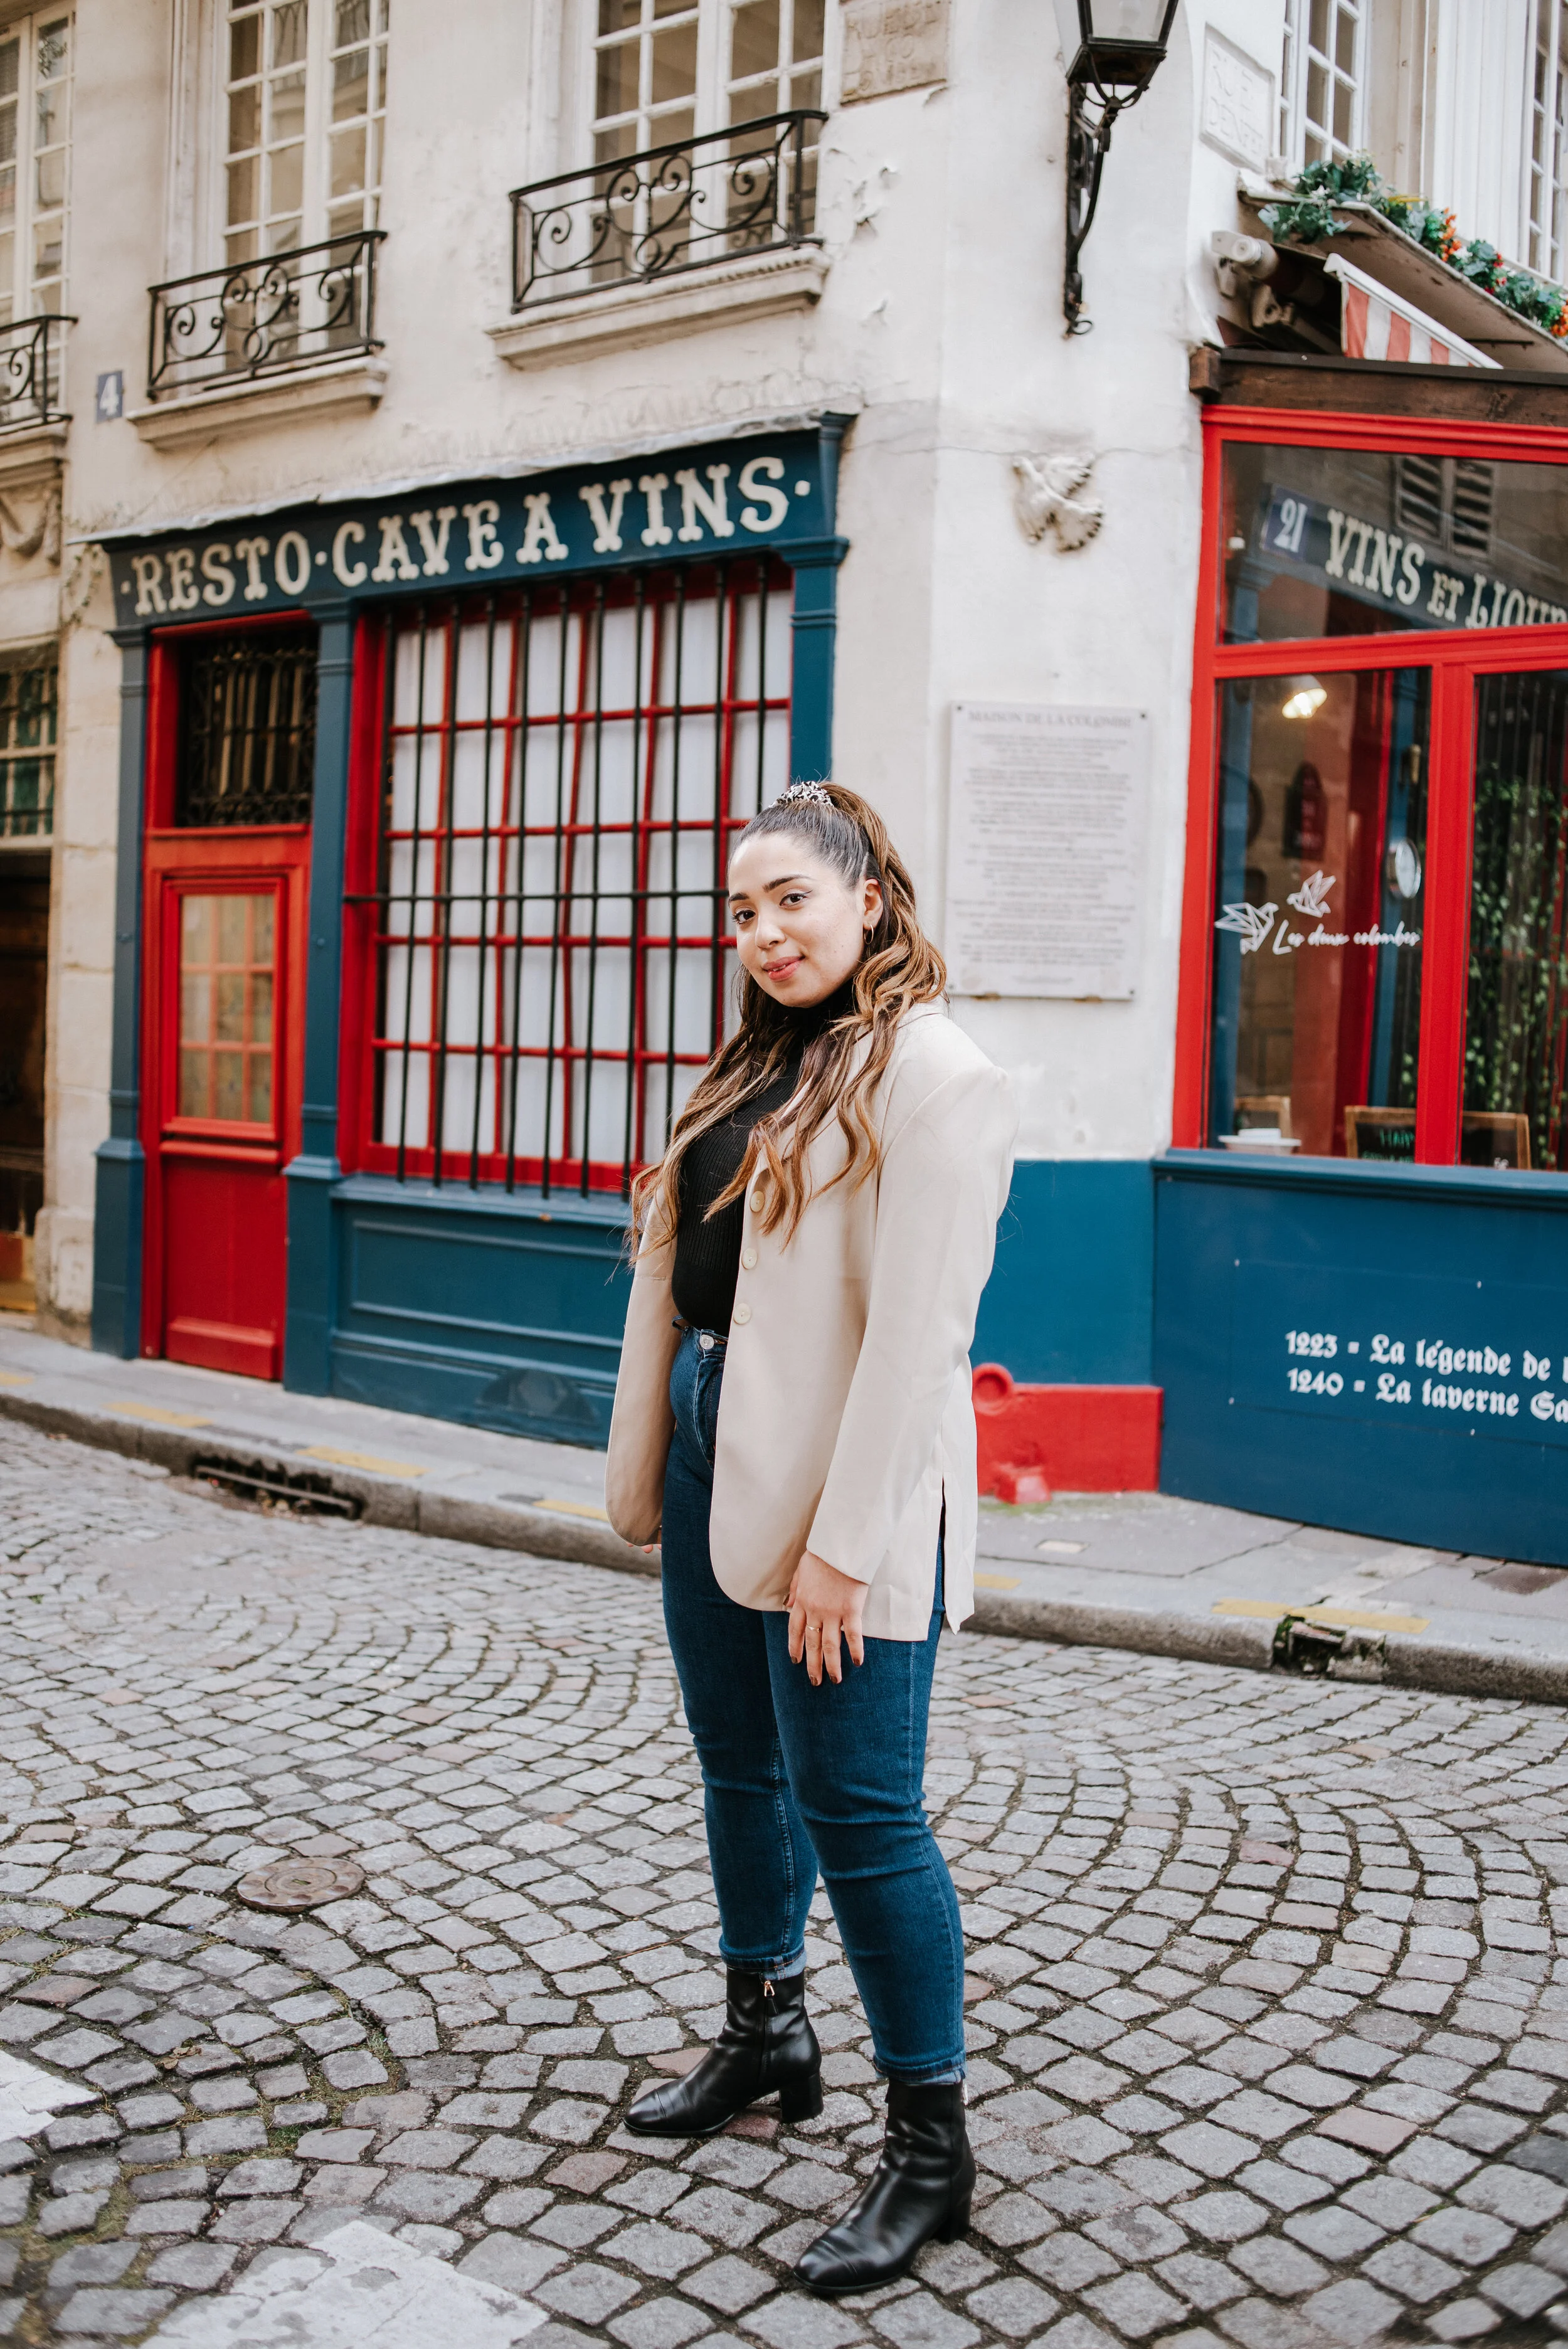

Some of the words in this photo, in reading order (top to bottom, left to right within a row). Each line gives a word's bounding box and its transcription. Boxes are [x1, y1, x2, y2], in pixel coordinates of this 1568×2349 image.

[100, 376, 119, 415] 4
[516, 492, 569, 563] A
[578, 456, 789, 553] VINS
[1273, 497, 1308, 554] 21
[1325, 508, 1426, 606] VINS
[1426, 571, 1465, 622] ET
[1273, 920, 1305, 955] Les
[1353, 920, 1421, 948] colombes
[1286, 1330, 1338, 1359] 1223
[1369, 1334, 1406, 1365] La
[1415, 1339, 1512, 1377] légende
[1522, 1349, 1551, 1382] de
[1287, 1367, 1344, 1397] 1240
[1375, 1372, 1412, 1404] La
[1421, 1377, 1520, 1418] taverne
